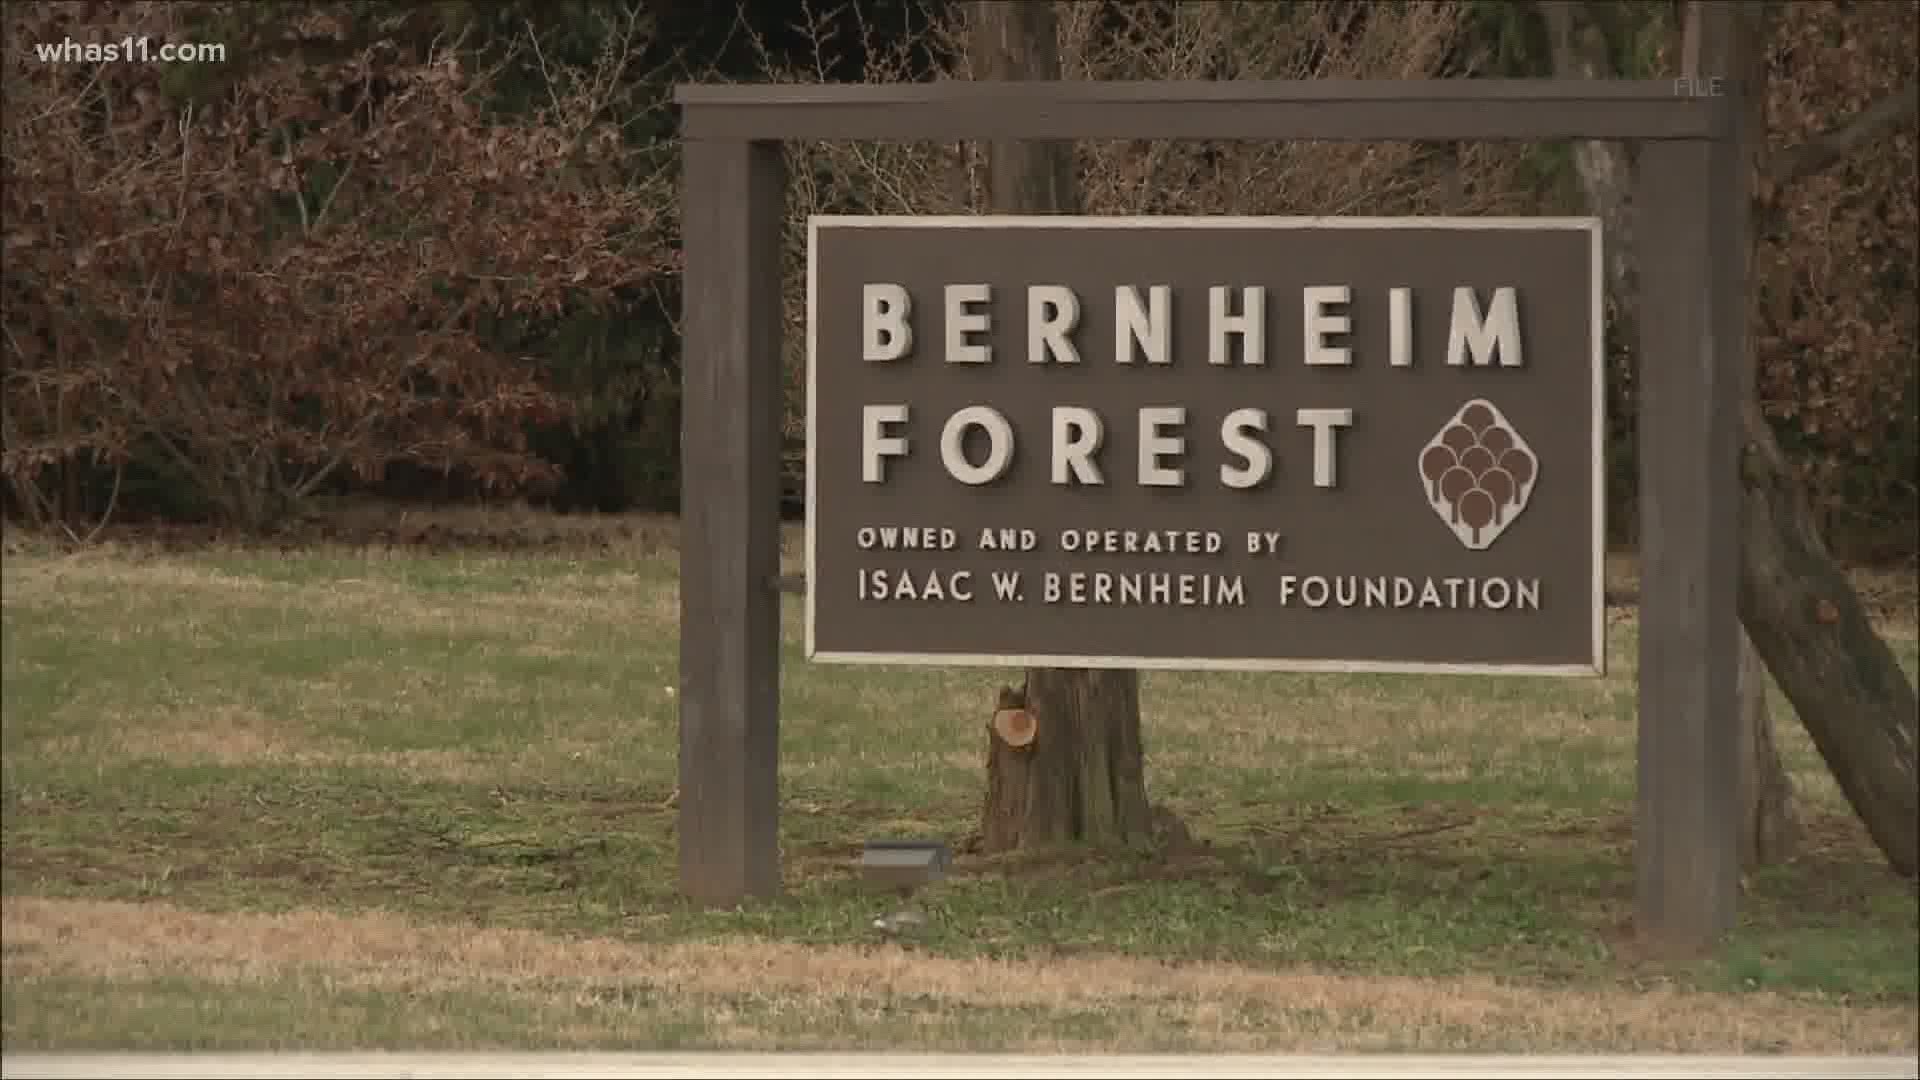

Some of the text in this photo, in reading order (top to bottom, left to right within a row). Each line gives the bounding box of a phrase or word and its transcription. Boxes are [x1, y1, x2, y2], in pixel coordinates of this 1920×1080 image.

[862, 282, 1524, 368] BERNHEIM
[862, 404, 1353, 488] FOREST
[857, 527, 1281, 554] OWNED AND OPERATED BY
[858, 569, 1541, 611] ISAAC W. BERNHEIM FOUNDATION
